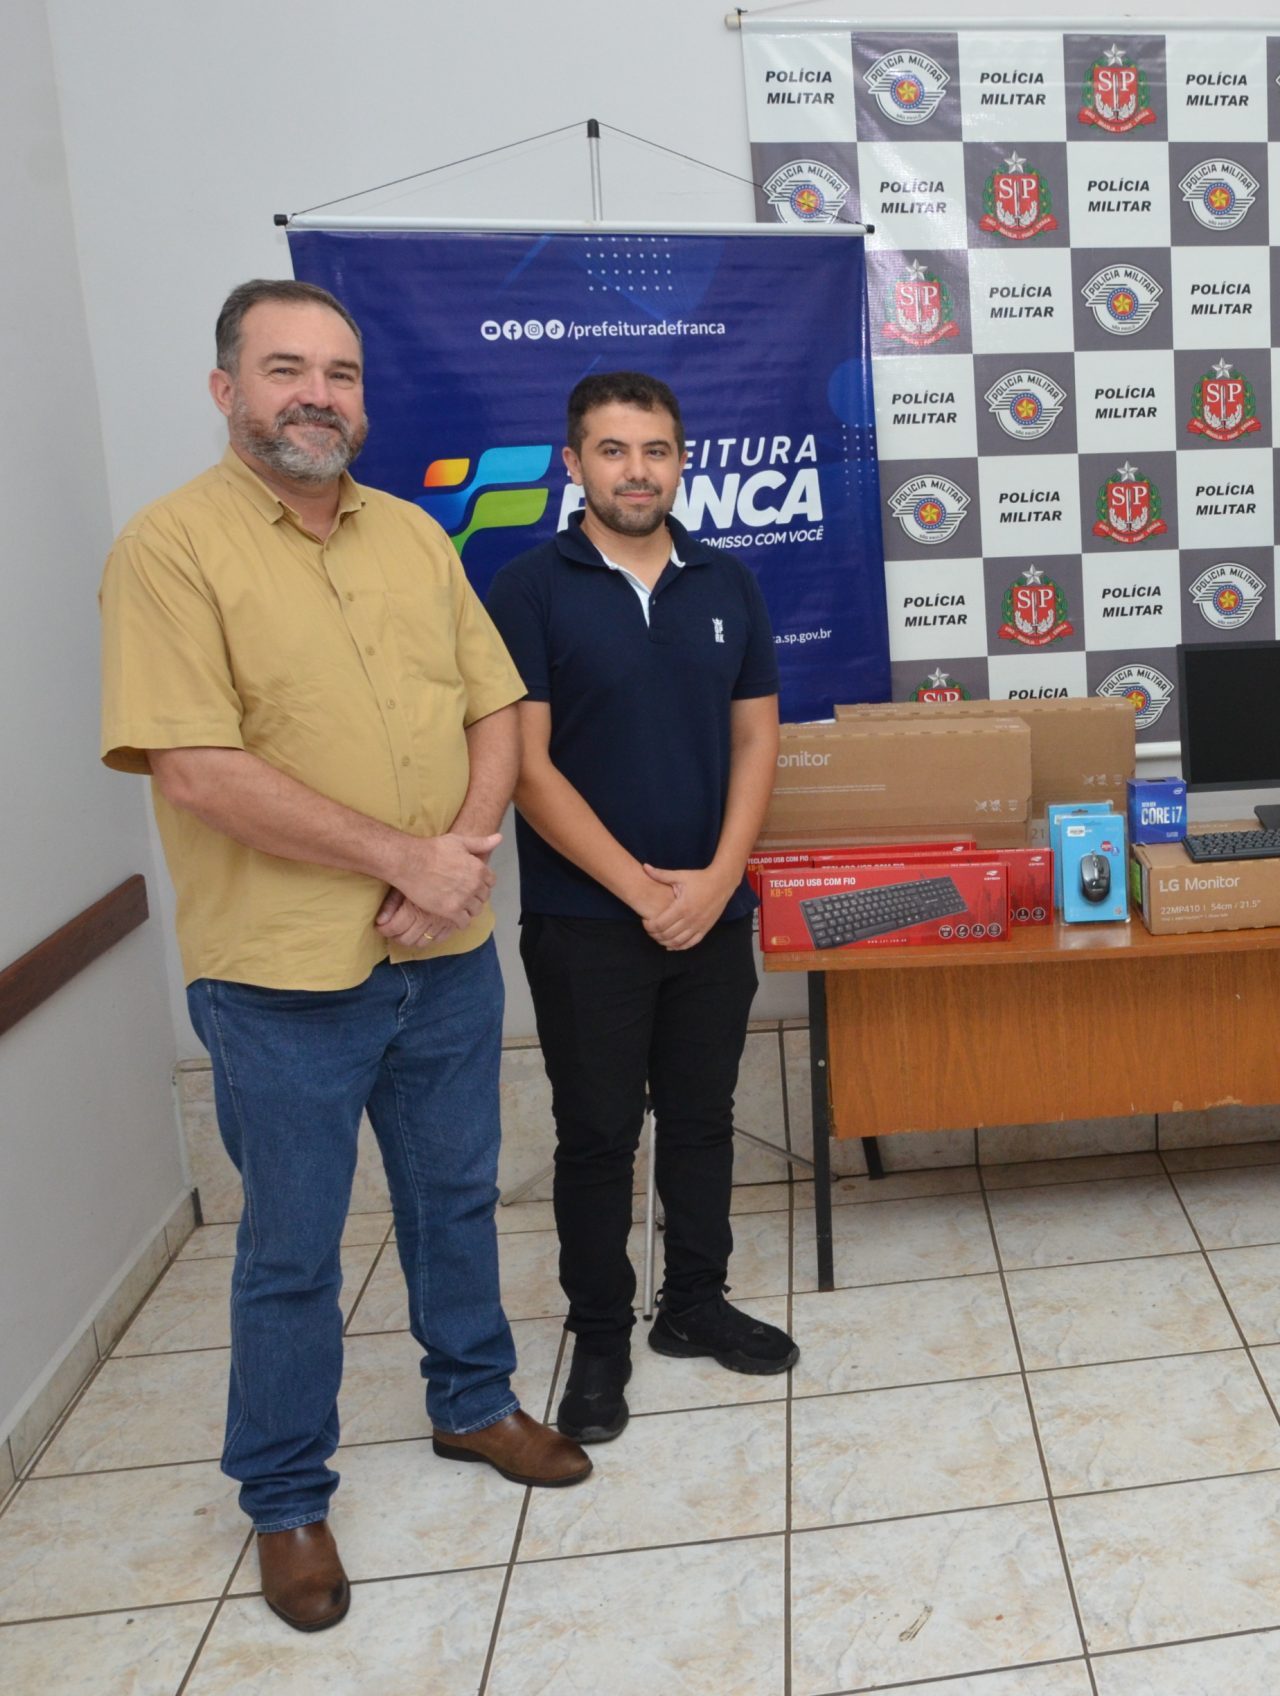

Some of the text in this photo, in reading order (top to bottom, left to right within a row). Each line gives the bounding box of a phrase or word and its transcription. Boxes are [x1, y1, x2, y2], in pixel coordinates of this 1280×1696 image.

[908, 55, 943, 81] MILITAR
[765, 68, 832, 83] POLÍCIA
[979, 70, 1044, 84] POLÍCIA
[1185, 72, 1248, 86] POLÍCIA
[766, 92, 835, 105] MILITAR
[980, 93, 1046, 105] MILITAR
[1186, 94, 1249, 107] MILITAR
[807, 165, 842, 192] MILITAR
[1221, 164, 1253, 189] MILITAR
[879, 179, 945, 193] POLÍCIA
[1087, 178, 1150, 192] POLÍCIA
[880, 202, 946, 214] MILITAR
[1088, 200, 1152, 212] MILITAR
[1124, 270, 1156, 294] MILITAR
[1190, 281, 1251, 295] POLÍCIA
[989, 284, 1052, 298] POLÍCIA
[990, 306, 1054, 318] MILITAR
[1191, 303, 1253, 315] MILITAR
[567, 320, 726, 340] /prefeituradefranca
[1027, 376, 1060, 400] MILITAR
[1094, 384, 1156, 400] POLÍCIA
[891, 390, 955, 405] POLÍCIA
[892, 412, 957, 425] MILITAR
[1095, 406, 1158, 419] MILITAR
[682, 434, 817, 469] EITURA
[931, 480, 963, 504] MILITAR
[998, 488, 1061, 504] POLÍCIA
[1195, 482, 1255, 497] POLÍCIA
[999, 510, 1063, 523] MILITAR
[1195, 503, 1257, 516] MILITAR
[755, 532, 786, 546] COM
[788, 525, 824, 543] VOCÊ
[1229, 568, 1260, 591] MILITAR
[1101, 584, 1162, 599] POLÍCIA
[903, 592, 966, 608] POLÍCIA
[1102, 604, 1164, 618] MILITAR
[904, 613, 968, 628] MILITAR
[774, 628, 832, 645] a.sp.gov.br
[1137, 669, 1167, 692] MILITAR
[1008, 686, 1068, 700] POLÍCIA
[776, 751, 832, 768] onitor
[1141, 806, 1183, 825] CORE i7
[748, 856, 773, 864] TECLADO
[769, 877, 856, 888] TECLADO USB COM FIO
[1159, 876, 1241, 892] LG Monitor
[770, 888, 793, 897] KB-15
[1160, 904, 1200, 915] 22MP410
[1211, 902, 1233, 912] 54cm
